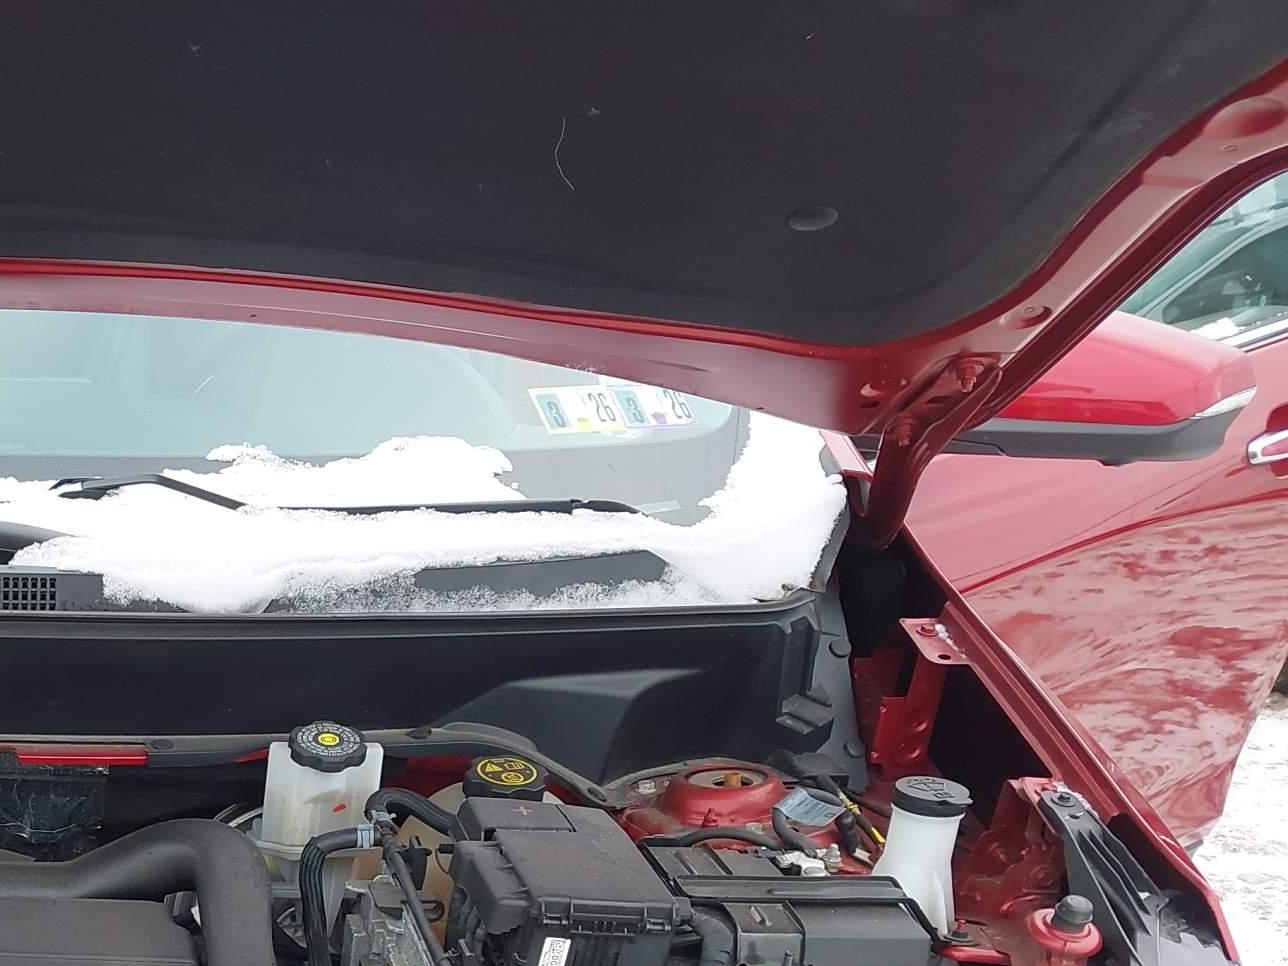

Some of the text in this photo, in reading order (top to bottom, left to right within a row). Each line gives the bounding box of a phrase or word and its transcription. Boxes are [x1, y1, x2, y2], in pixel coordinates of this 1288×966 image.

[547, 393, 616, 427] 3 26
[625, 397, 645, 423] 3
